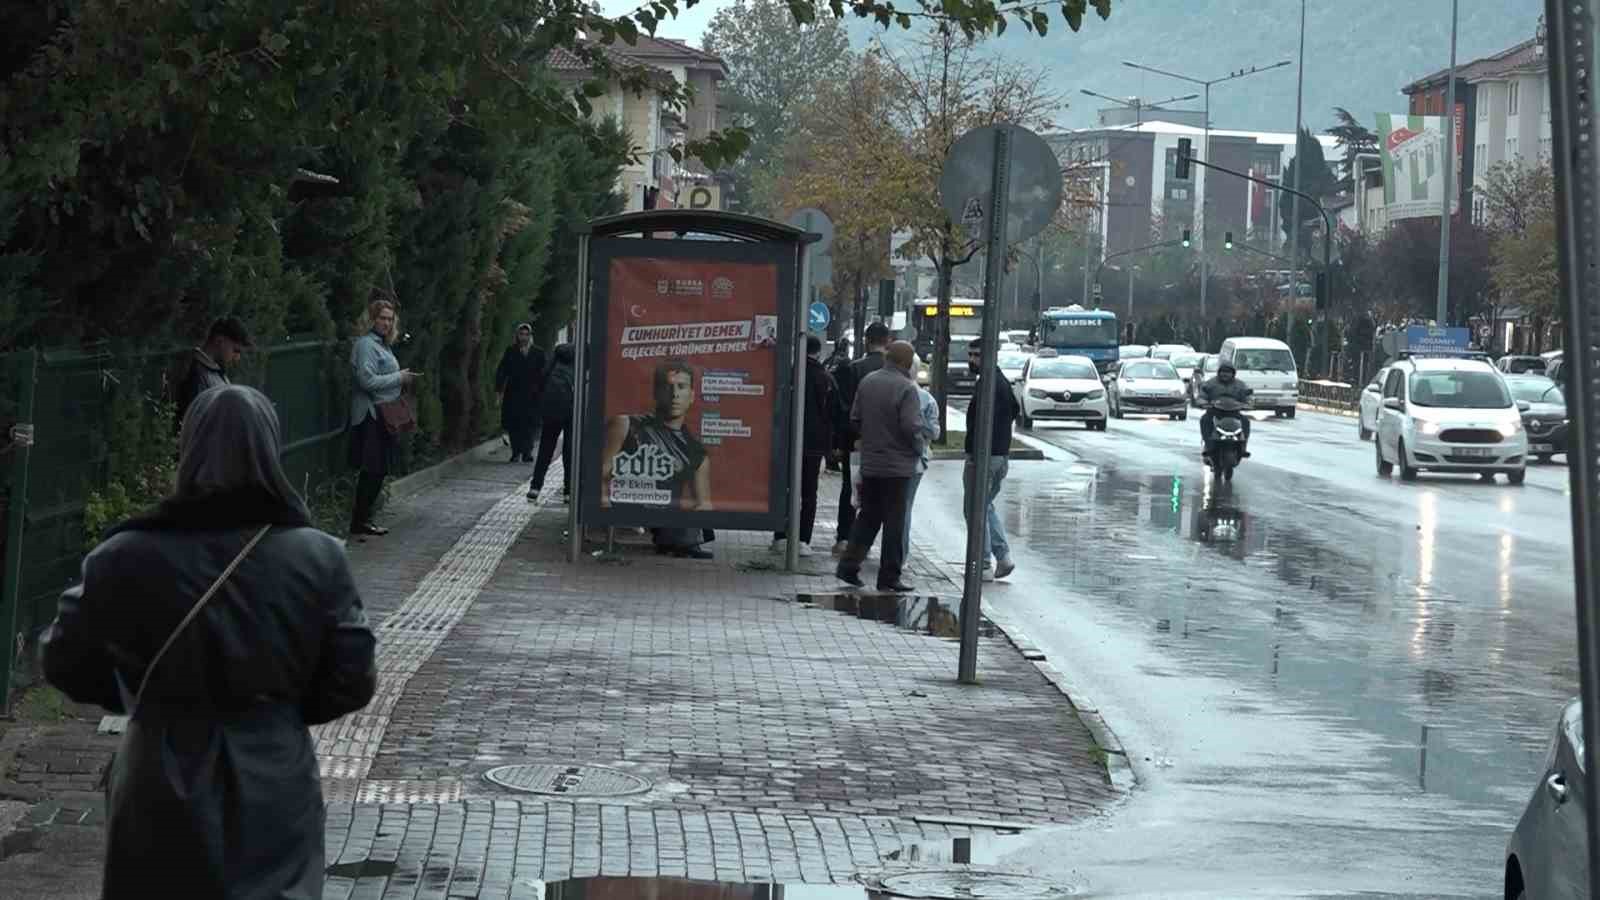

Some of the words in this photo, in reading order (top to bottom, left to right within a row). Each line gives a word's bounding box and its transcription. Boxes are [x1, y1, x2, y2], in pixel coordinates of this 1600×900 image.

[628, 325, 702, 341] CUMHURİYET
[704, 324, 744, 337] DEMEK
[669, 343, 714, 356] YÜRÜMEK
[715, 342, 748, 352] DEMEK
[613, 480, 626, 489] 29
[629, 480, 654, 489] Ekim
[612, 490, 669, 502] Çarşamba
